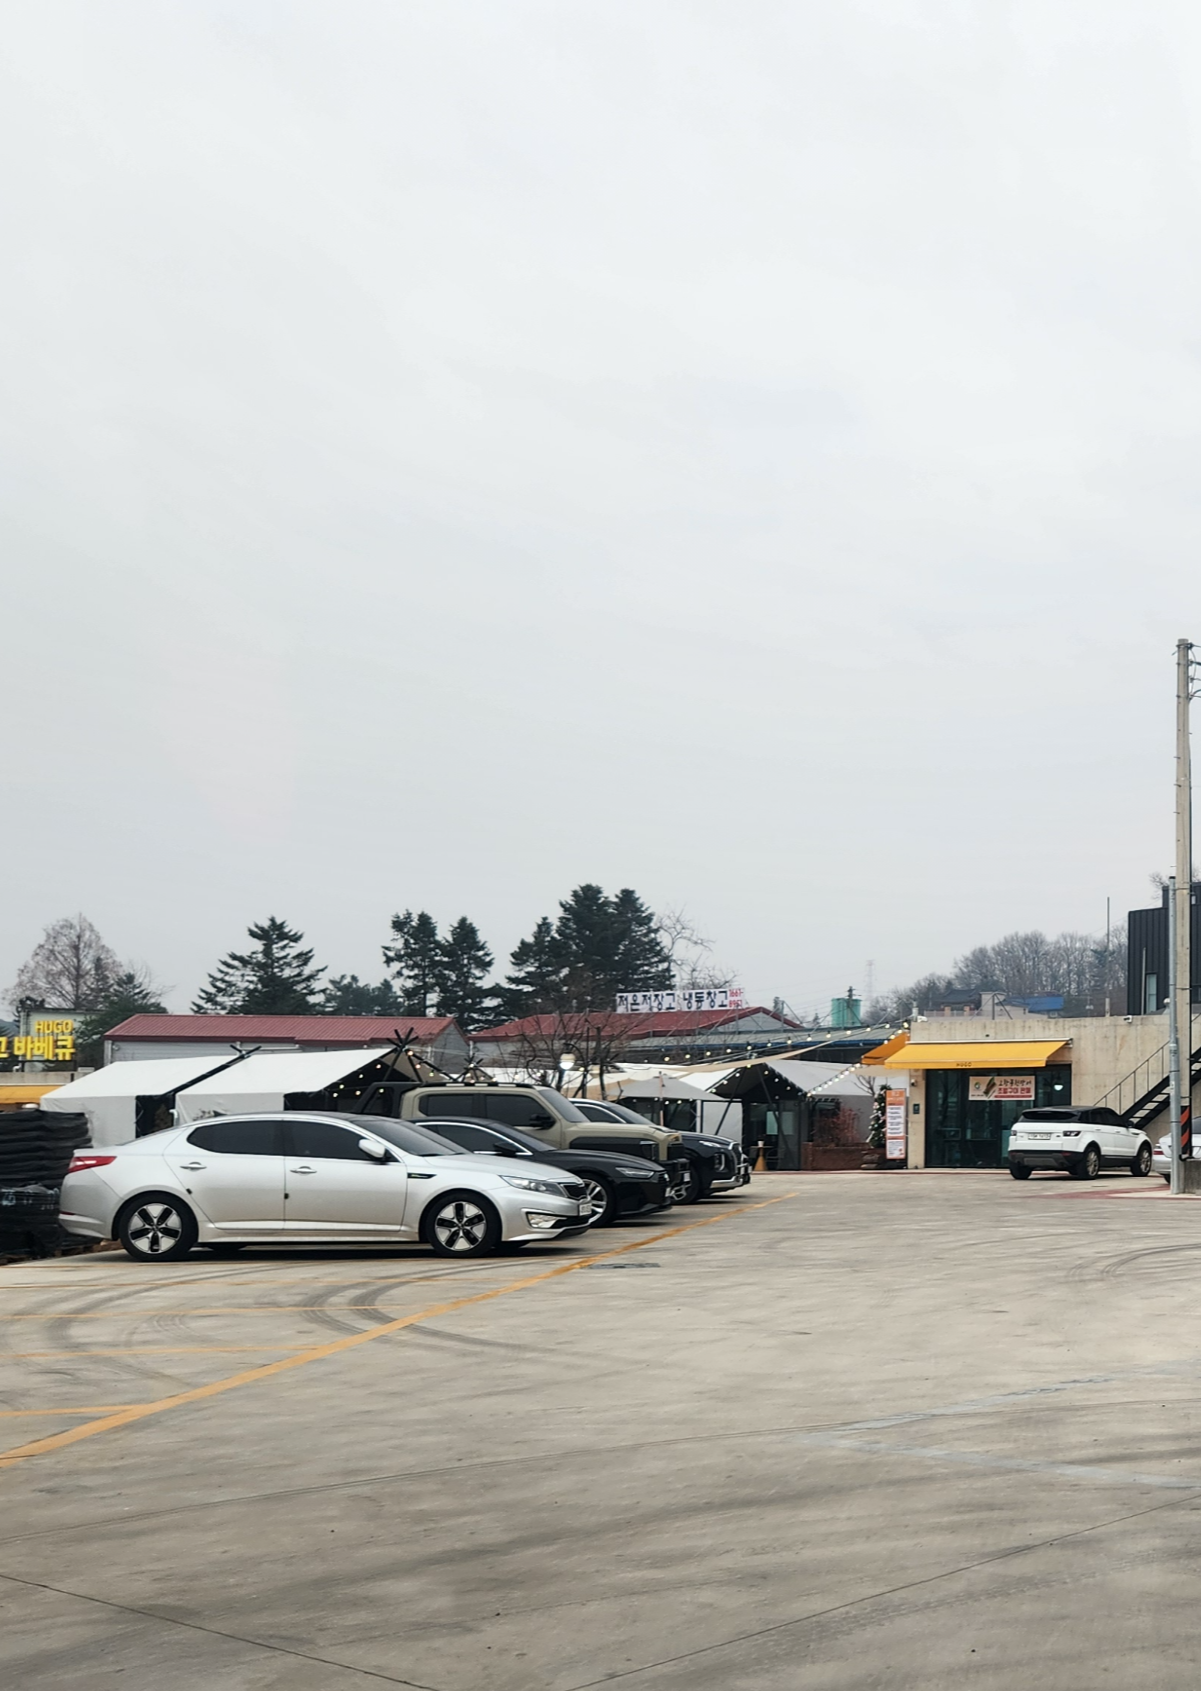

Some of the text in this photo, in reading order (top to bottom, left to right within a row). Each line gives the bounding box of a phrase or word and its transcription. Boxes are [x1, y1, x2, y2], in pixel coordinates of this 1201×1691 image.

[618, 990, 728, 1012] 저온저장고 냉동창고
[35, 1020, 74, 1033] HUGO
[13, 1035, 76, 1060] 바베큐
